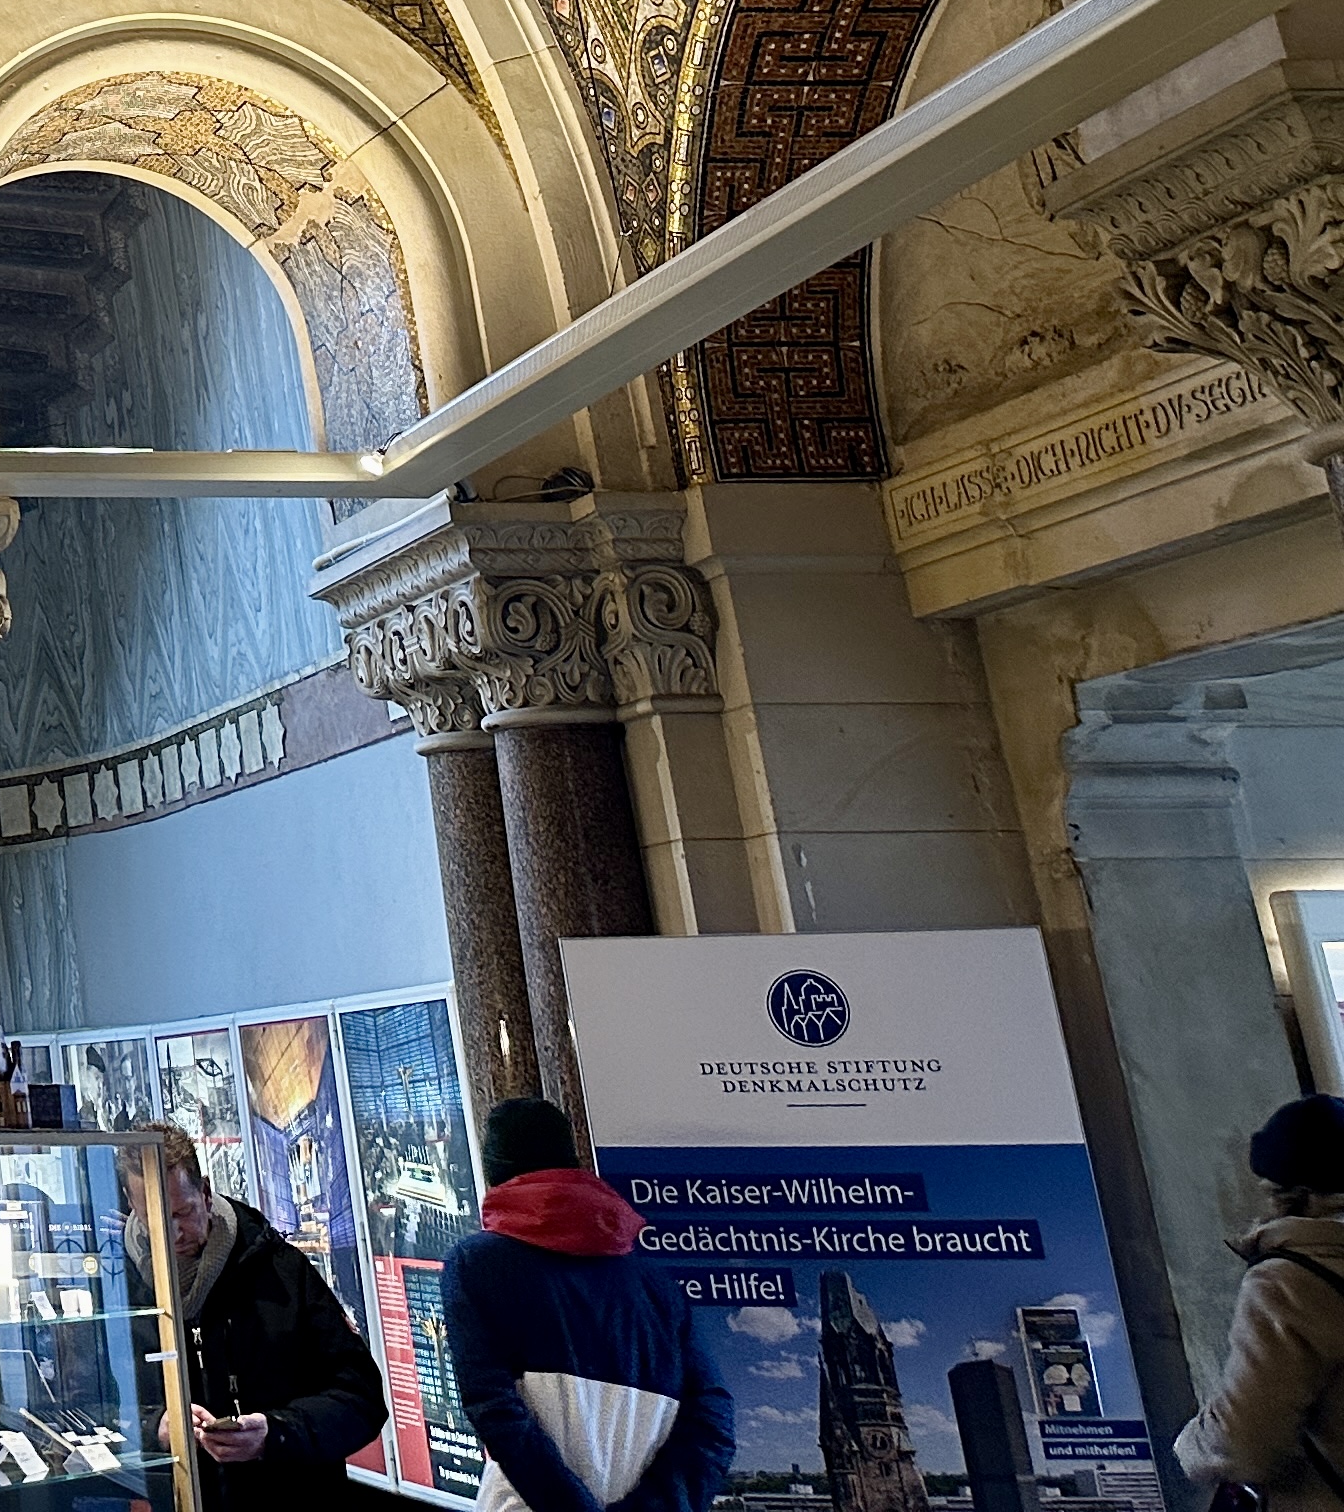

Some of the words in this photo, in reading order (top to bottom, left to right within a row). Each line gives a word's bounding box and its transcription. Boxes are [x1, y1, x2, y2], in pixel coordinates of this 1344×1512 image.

[699, 1061, 819, 1076] DEUTSCHE
[826, 1059, 943, 1074] STIFTUNG
[720, 1077, 927, 1093] DENKMALSCHUTZ
[631, 1178, 679, 1204] Die
[686, 1178, 914, 1205] Kaiser-Wilhelm-
[638, 1226, 906, 1253] Gedächtnis-Kirche
[912, 1225, 1032, 1253] braucht
[709, 1273, 785, 1300] Hilfe!
[1044, 1423, 1114, 1435] Mitnehmen
[1049, 1444, 1073, 1455] und
[1075, 1444, 1137, 1457] mithelfen!
